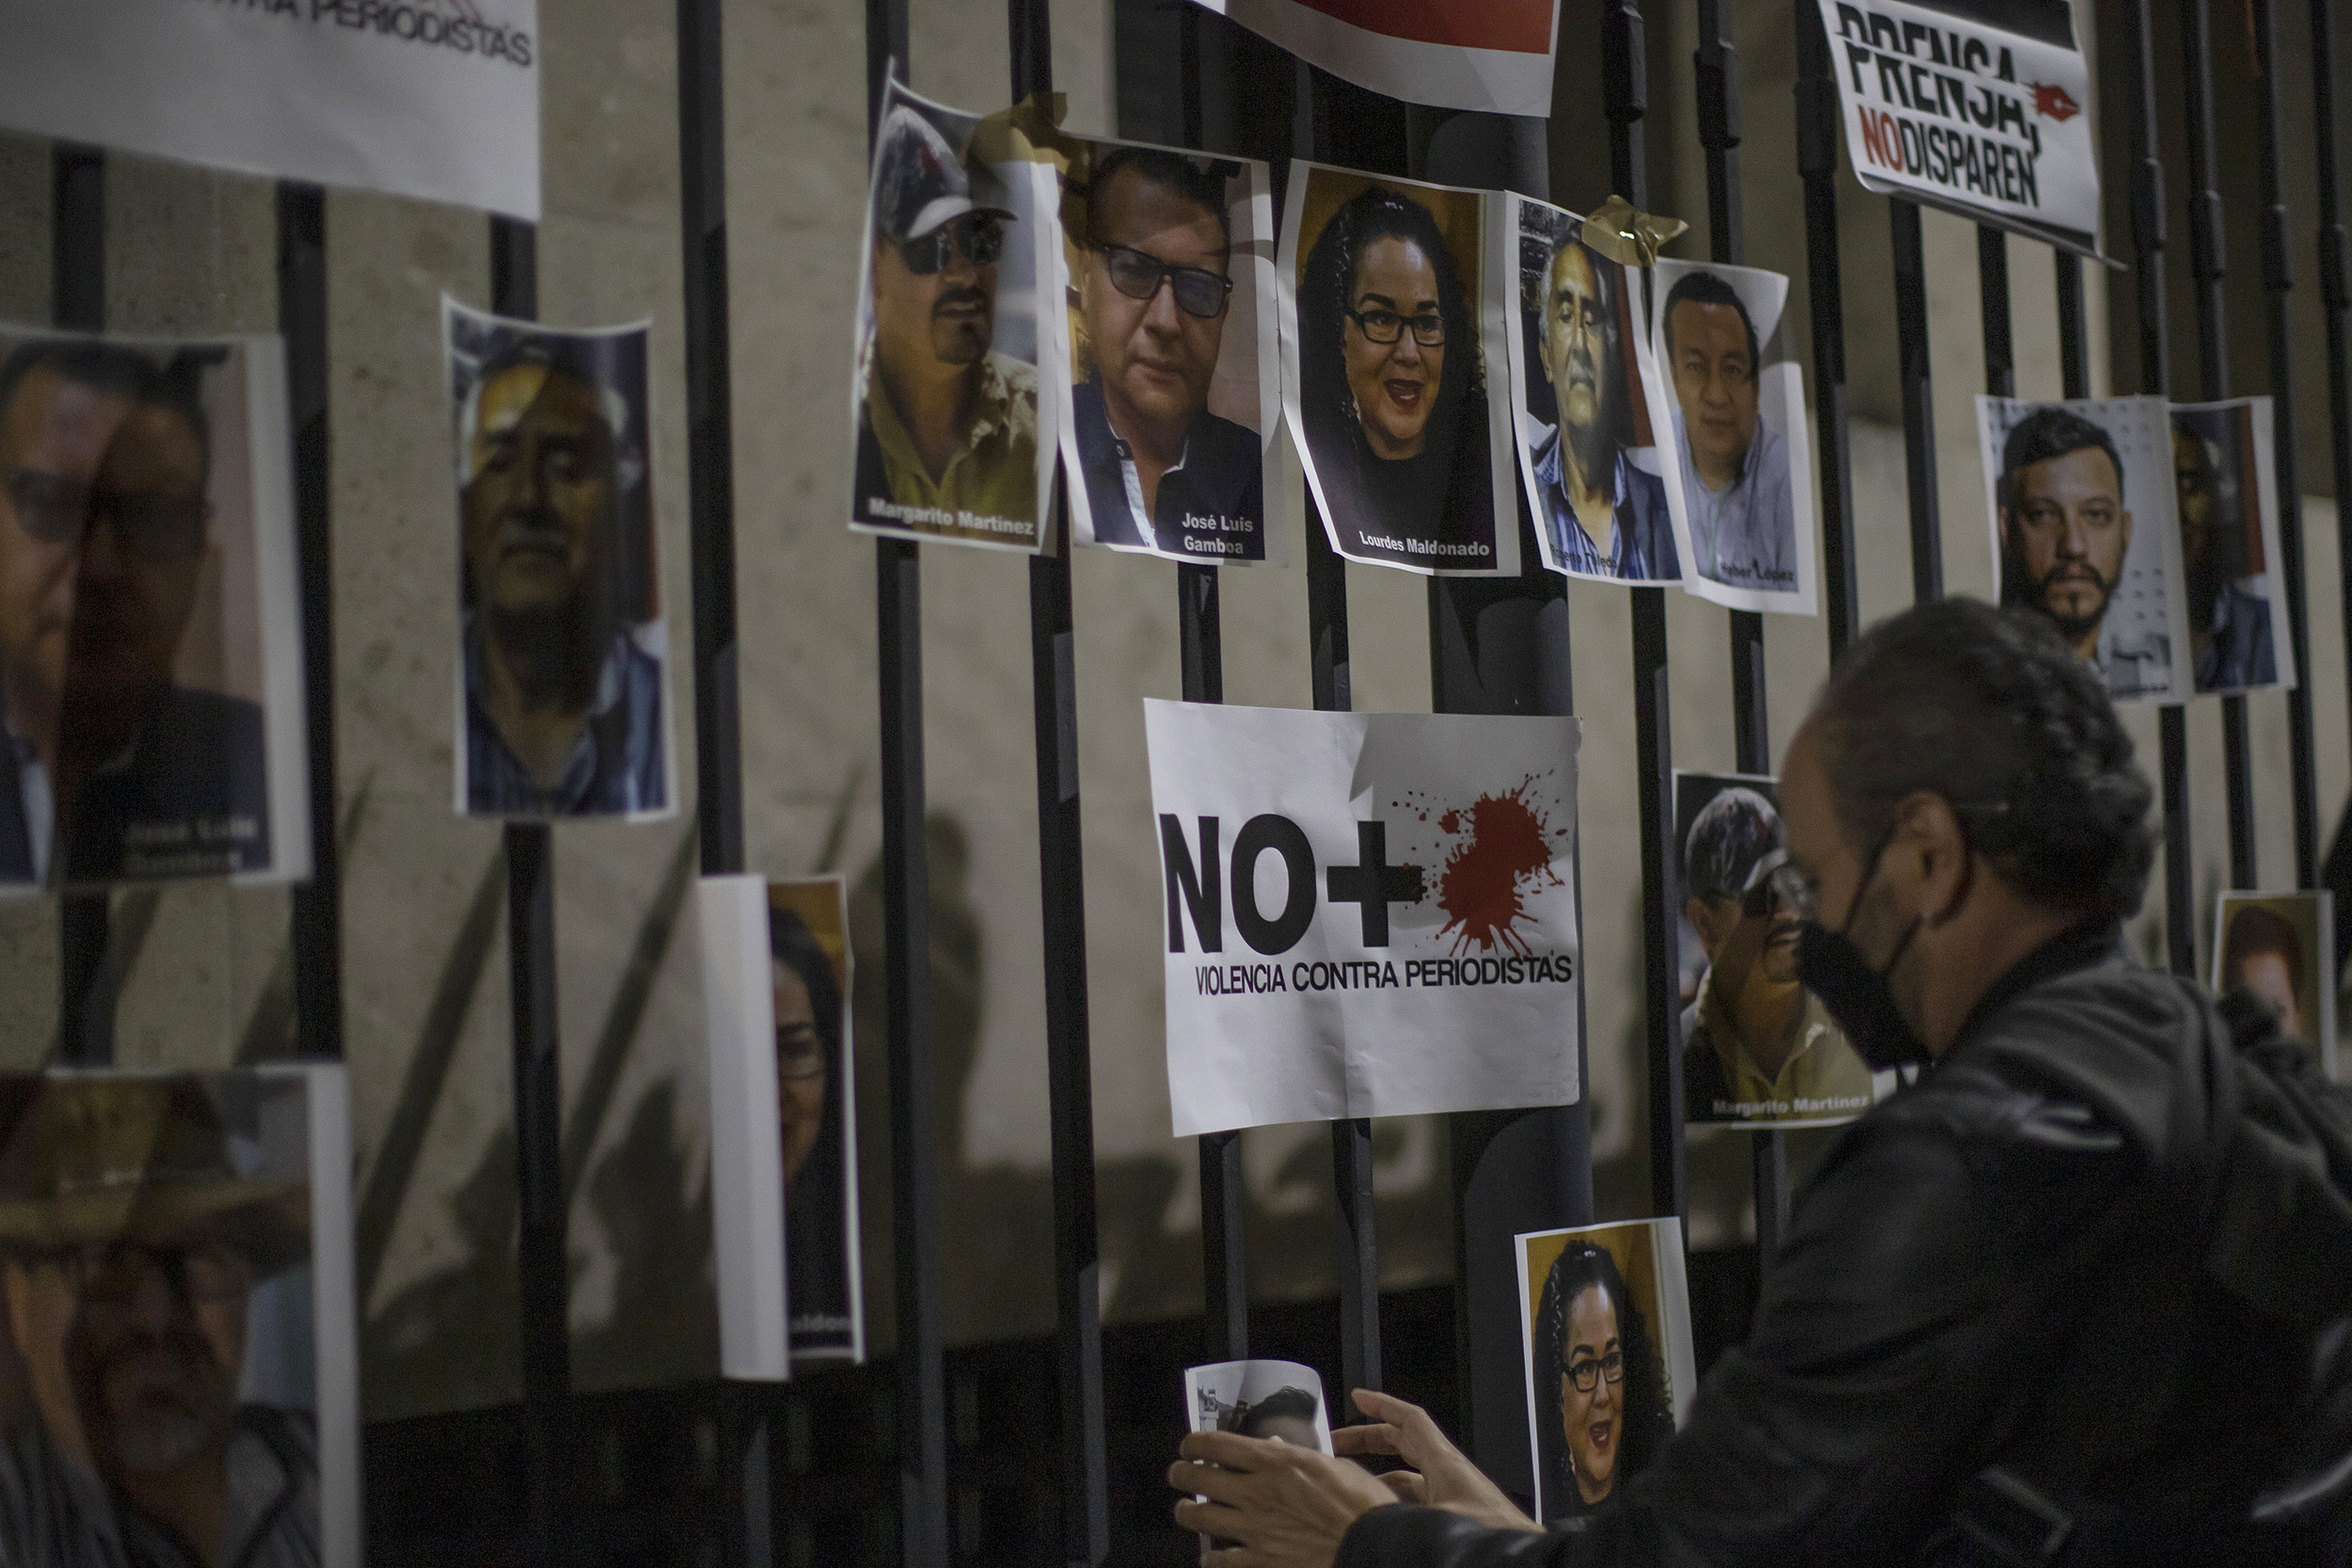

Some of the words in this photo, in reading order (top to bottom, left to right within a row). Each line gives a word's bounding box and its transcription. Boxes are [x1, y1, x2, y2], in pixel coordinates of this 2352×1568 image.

[310, 0, 532, 68] PERIODISTAS
[867, 497, 954, 526] Margarito
[1182, 513, 1217, 531] José
[1220, 515, 1254, 532] Luis
[1184, 535, 1245, 555] Gamboa
[1359, 531, 1405, 552] Lourdes
[1406, 538, 1490, 556] Maldonado
[1196, 962, 1287, 995] VIOLENCIA
[1292, 960, 1399, 990] CONTRA
[1405, 955, 1572, 987] PERIODISTAS
[1712, 1098, 1788, 1117] Margarito
